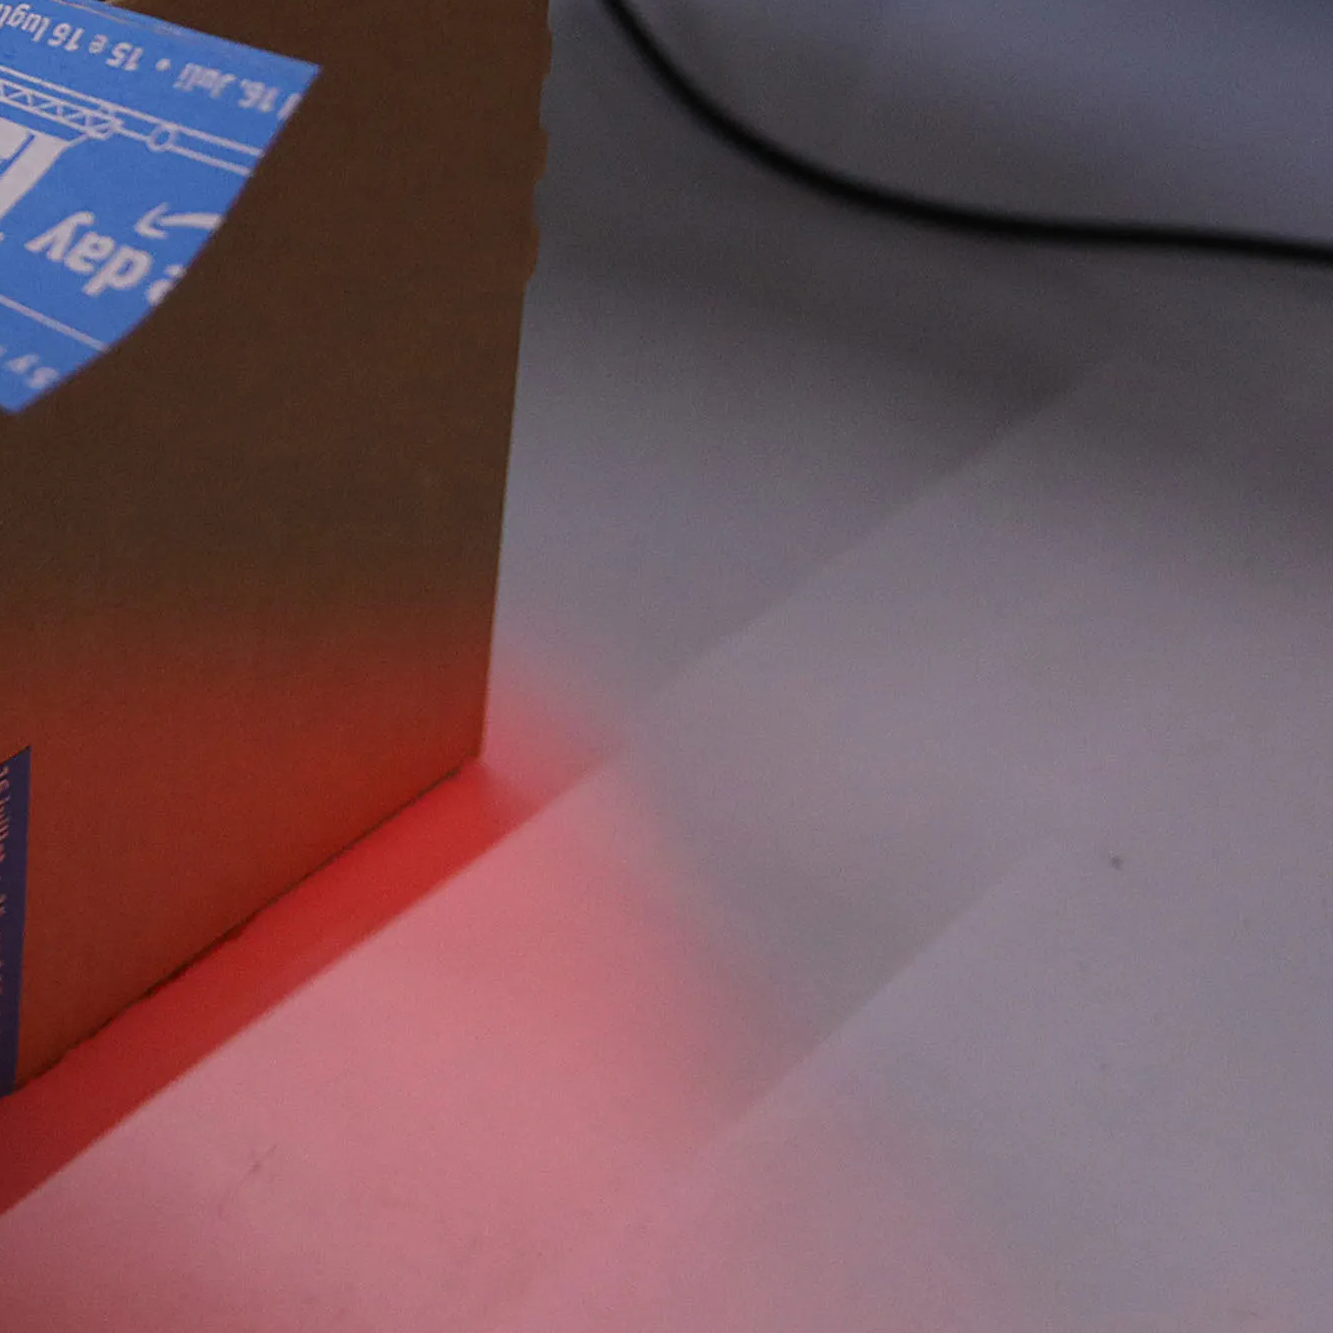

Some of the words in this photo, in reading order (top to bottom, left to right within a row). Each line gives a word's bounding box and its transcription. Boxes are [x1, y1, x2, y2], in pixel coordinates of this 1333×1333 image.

[47, 22, 85, 52] 16
[88, 34, 109, 54] e
[106, 42, 144, 71] 15
[25, 210, 155, 298] day
